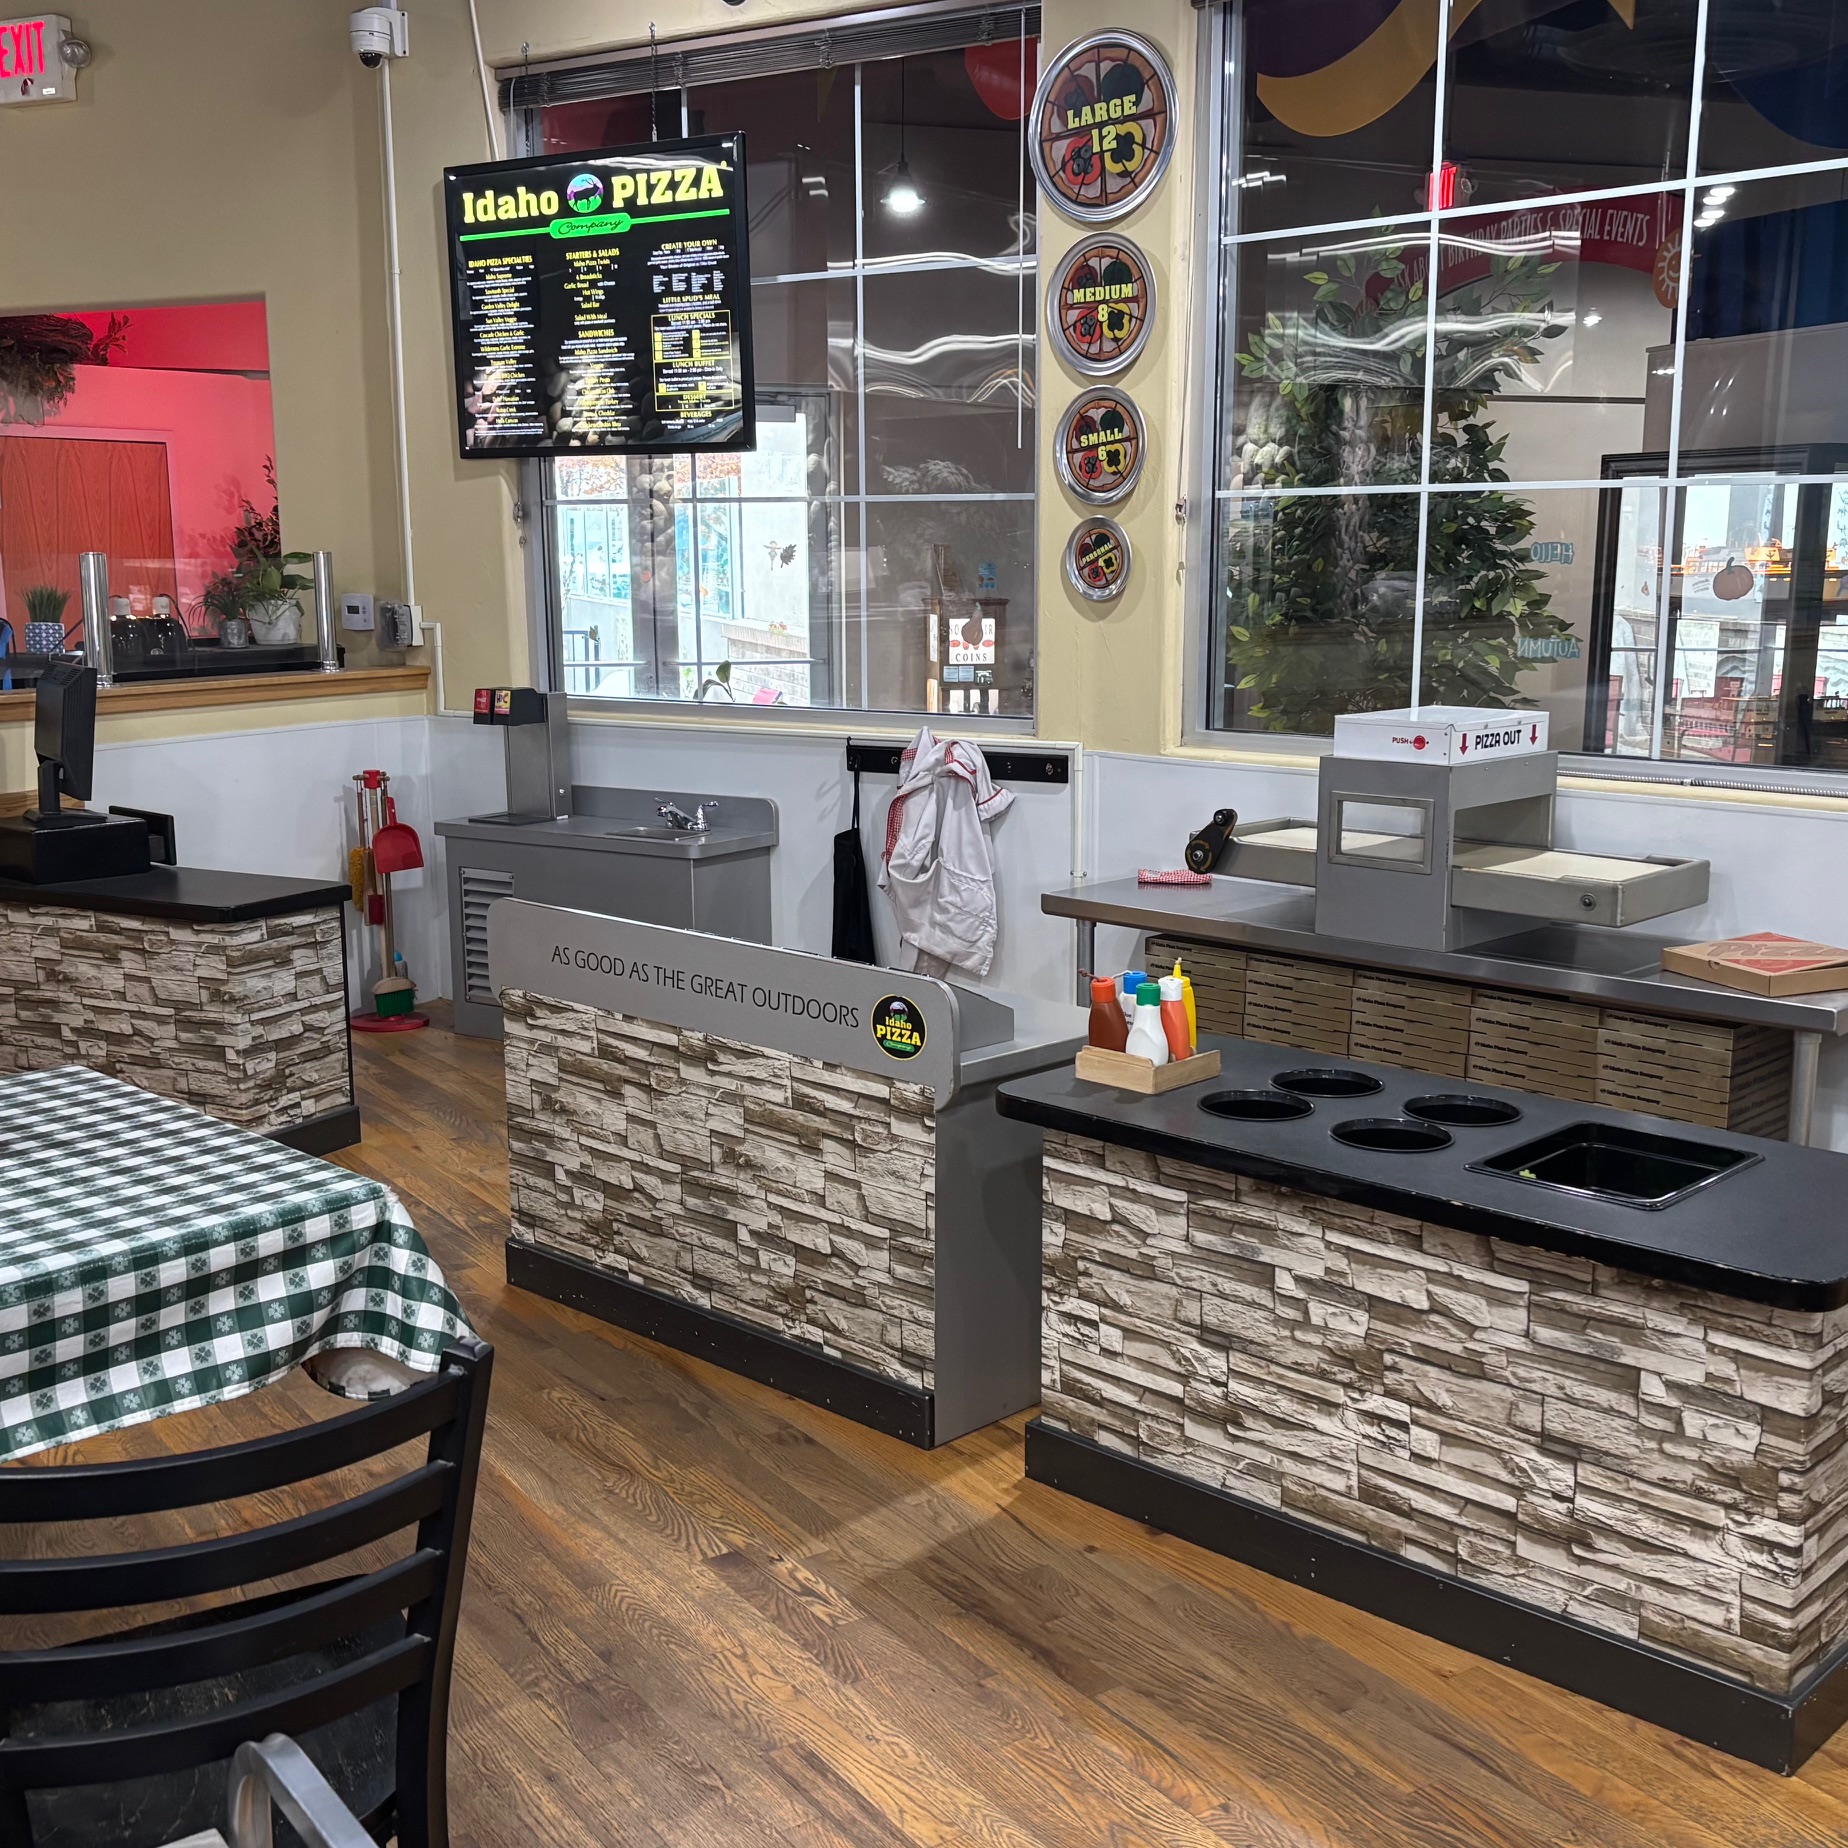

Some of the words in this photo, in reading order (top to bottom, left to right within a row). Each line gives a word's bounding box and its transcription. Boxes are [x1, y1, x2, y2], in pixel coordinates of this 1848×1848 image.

[0, 20, 45, 78] EXIT
[1066, 94, 1137, 130] LARGE
[1092, 124, 1118, 153] 12
[463, 187, 559, 224] Idaho
[611, 165, 724, 208] PIZZA
[558, 219, 624, 235] Company
[1603, 209, 1651, 247] EVENTS
[566, 251, 591, 260] STARTERS
[598, 248, 619, 257] SALADS
[1073, 282, 1133, 304] MEDIUM
[1098, 303, 1109, 323] 8
[1080, 427, 1123, 447] SMALL
[1098, 445, 1107, 462] 6
[1082, 542, 1112, 564] PERSONAL
[955, 653, 987, 662] COINS
[1392, 737, 1409, 745] PUSH
[1475, 732, 1501, 750] PIZZA
[1503, 729, 1522, 745] OUT
[551, 945, 571, 966] AS
[575, 950, 625, 978] GOOD
[629, 962, 650, 983] AS
[653, 966, 685, 991] THE
[690, 974, 747, 1004] GREAT
[752, 987, 860, 1029] OUTDOORS
[885, 1016, 912, 1029] Idaho
[876, 1025, 921, 1046] PIZZA
